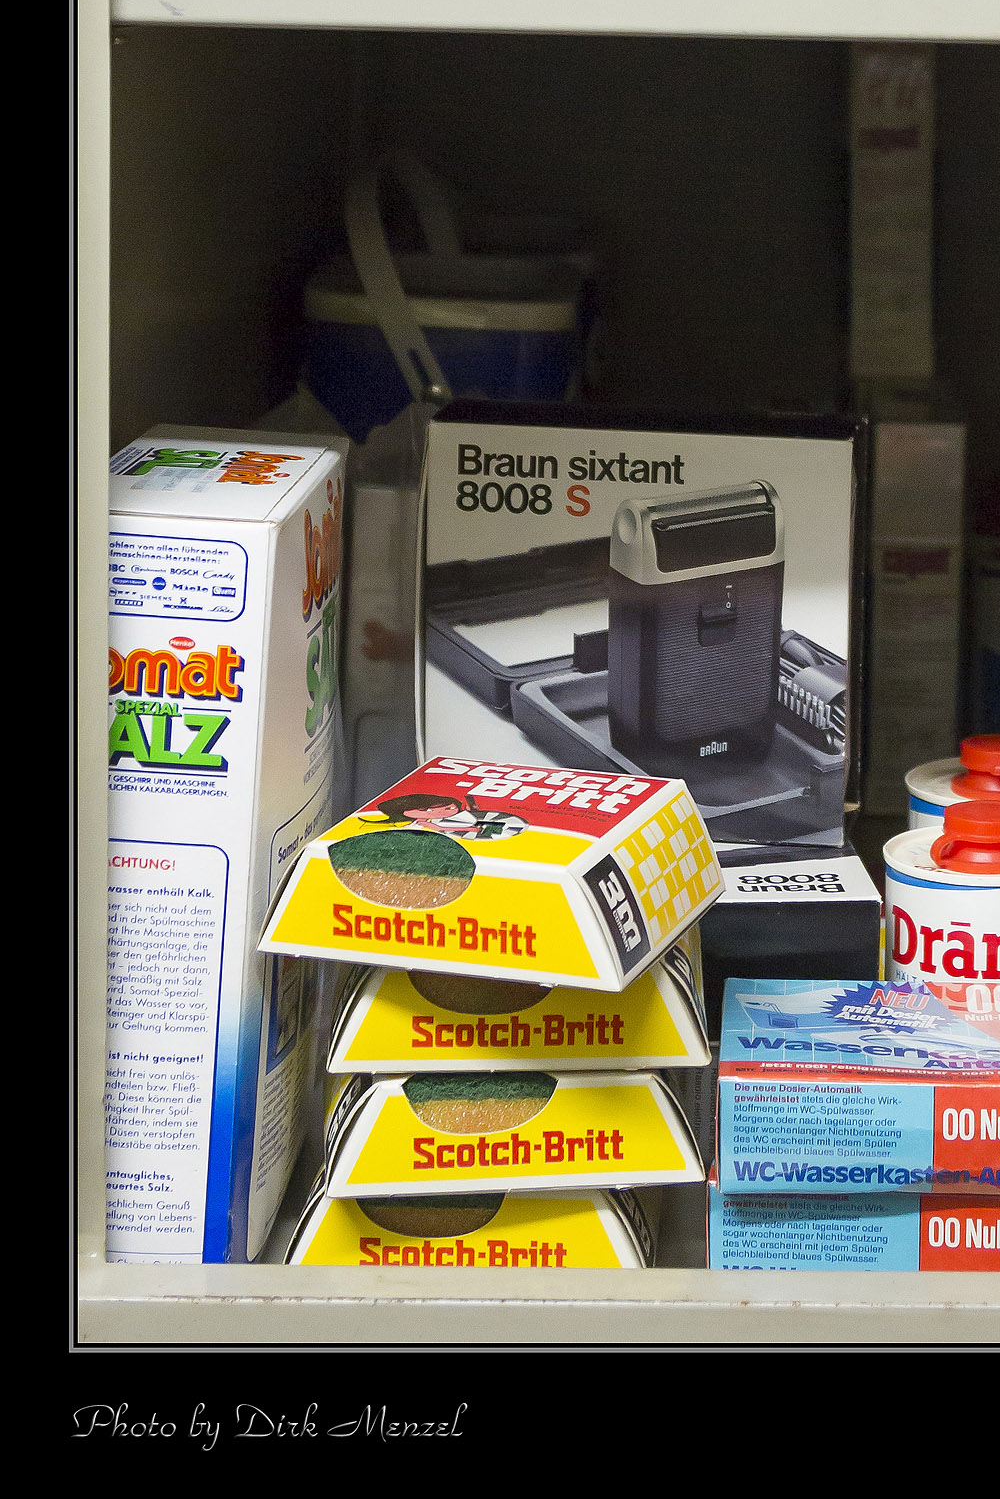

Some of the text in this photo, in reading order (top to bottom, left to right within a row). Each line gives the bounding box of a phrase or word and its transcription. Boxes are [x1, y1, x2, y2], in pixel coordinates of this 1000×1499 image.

[457, 444, 685, 486] Braun sixtant
[456, 480, 591, 517] 8008 S
[157, 544, 179, 553] allen
[182, 543, 229, 556] führenden
[170, 568, 199, 577] BOSCH
[115, 699, 182, 717] SPEZIAL
[154, 777, 171, 786] UND
[173, 779, 216, 788] MASCHINE
[424, 758, 651, 796] Scotch
[738, 873, 840, 884] 8008
[147, 887, 215, 899] enthält Kalk.
[737, 883, 845, 893] Braun
[332, 903, 537, 959] Scotch-Britt
[870, 989, 929, 1011] NEU
[842, 1005, 946, 1021] mit Dosier-
[834, 1011, 939, 1030] Automatik
[411, 1013, 625, 1049] Scotch-Britt
[123, 1052, 204, 1065] nicht geeignet!
[734, 1083, 863, 1095] Die neue Dosier-Automatik
[734, 1093, 800, 1104] gewährleistet
[733, 1114, 774, 1125] Morgens
[828, 1127, 902, 1139] Nichtbenutzung
[413, 1128, 625, 1170] Scotch-Britt
[864, 1138, 897, 1149] Spülen
[359, 1236, 567, 1267] Scotch-Britt
